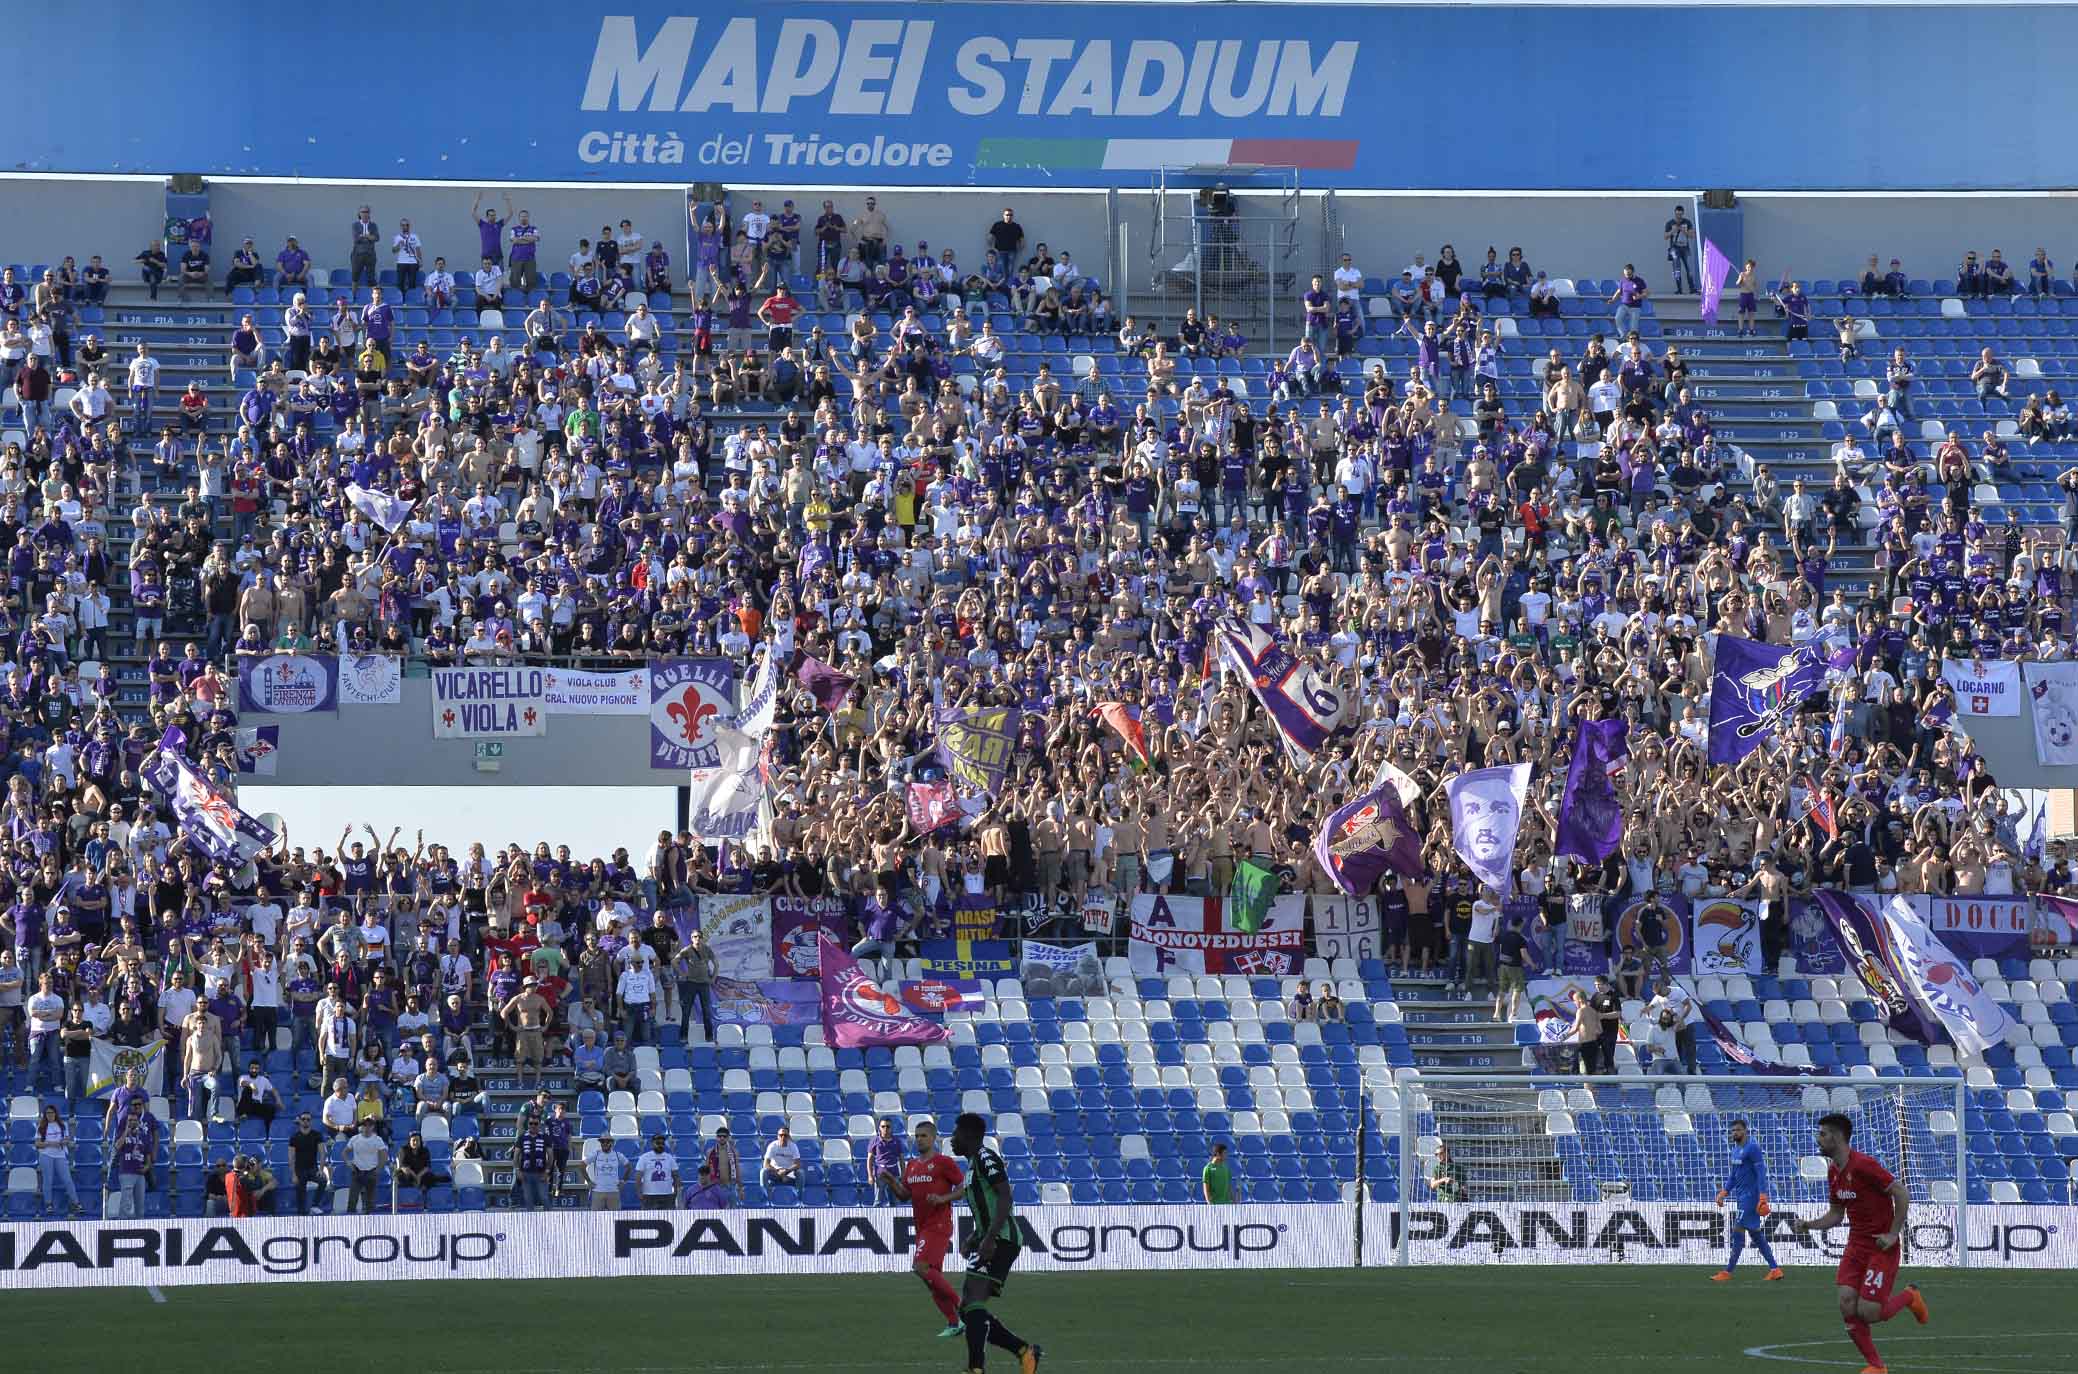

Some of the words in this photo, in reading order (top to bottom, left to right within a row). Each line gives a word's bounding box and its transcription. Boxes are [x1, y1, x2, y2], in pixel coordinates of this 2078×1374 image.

[580, 16, 935, 115] MAPEI
[947, 36, 1360, 117] STADIUM
[578, 131, 683, 165] Città
[697, 133, 751, 165] del
[764, 133, 953, 167] Tricolore
[567, 677, 592, 687] VIOLA
[594, 678, 616, 687] CLUB
[654, 663, 729, 691] QUELLI
[434, 671, 543, 699] VICARELLO
[1957, 680, 2005, 694] LOCARNO
[273, 690, 316, 699] FIRENZE
[545, 694, 566, 703] CRAL
[569, 694, 597, 704] NUOVO
[600, 695, 637, 705] PIGNONE
[461, 703, 518, 732] VIOLA
[1148, 896, 1176, 928] A
[1131, 922, 1301, 949] UNONOVEDUESEI
[931, 960, 1000, 971] PESINA
[1421, 1035, 1432, 1043] 10
[1471, 1035, 1481, 1043] 10
[1428, 1057, 1439, 1065] 09
[1478, 1057, 1490, 1065] 09
[498, 1080, 510, 1089] 08
[549, 1081, 561, 1089] 08
[500, 1103, 512, 1112] 07
[502, 1127, 514, 1136] 06
[561, 1198, 573, 1207] 03
[1864, 1269, 1884, 1289] 24
